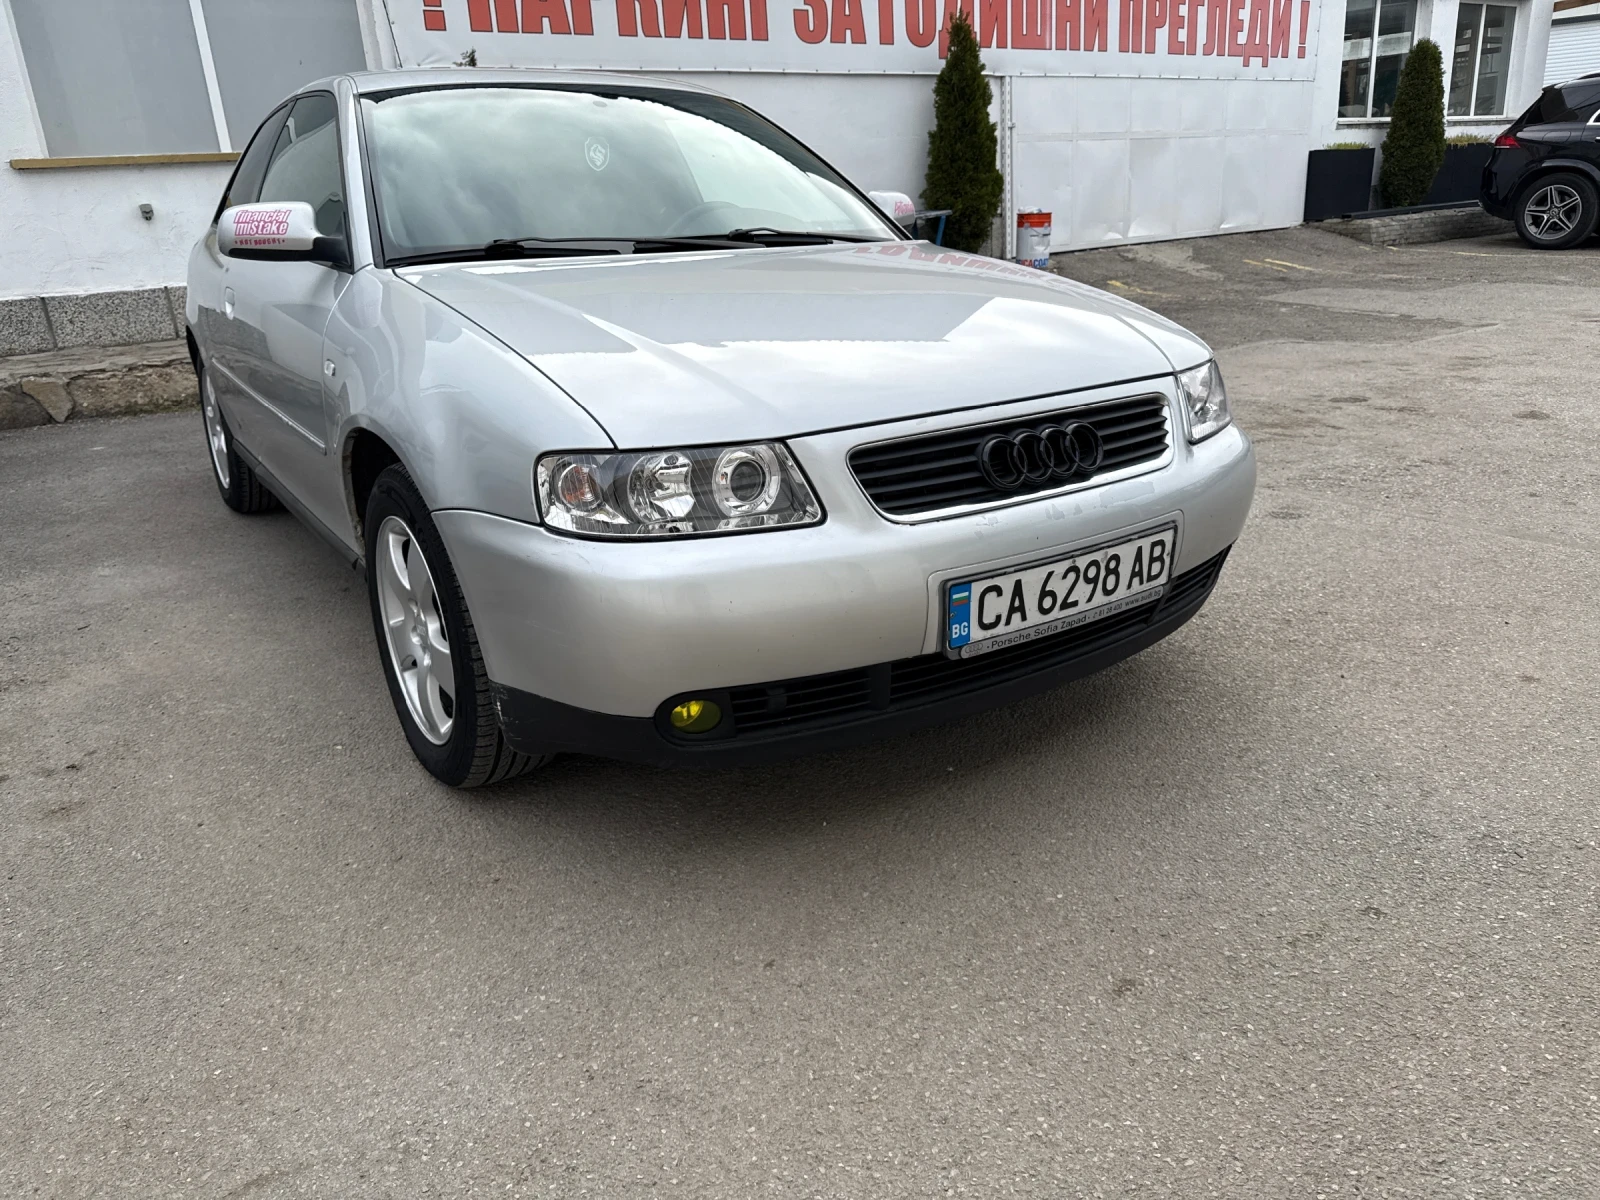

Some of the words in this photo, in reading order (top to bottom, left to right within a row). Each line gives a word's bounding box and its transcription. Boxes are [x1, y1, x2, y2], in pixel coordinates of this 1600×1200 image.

[233, 209, 292, 224] financial
[977, 578, 1028, 631] CA
[1037, 552, 1121, 616] 6298
[1126, 538, 1166, 591] AB
[952, 621, 969, 639] BG
[991, 632, 1031, 649] Porsche
[1034, 624, 1058, 638] Sofia
[1060, 614, 1087, 629] Zapad
